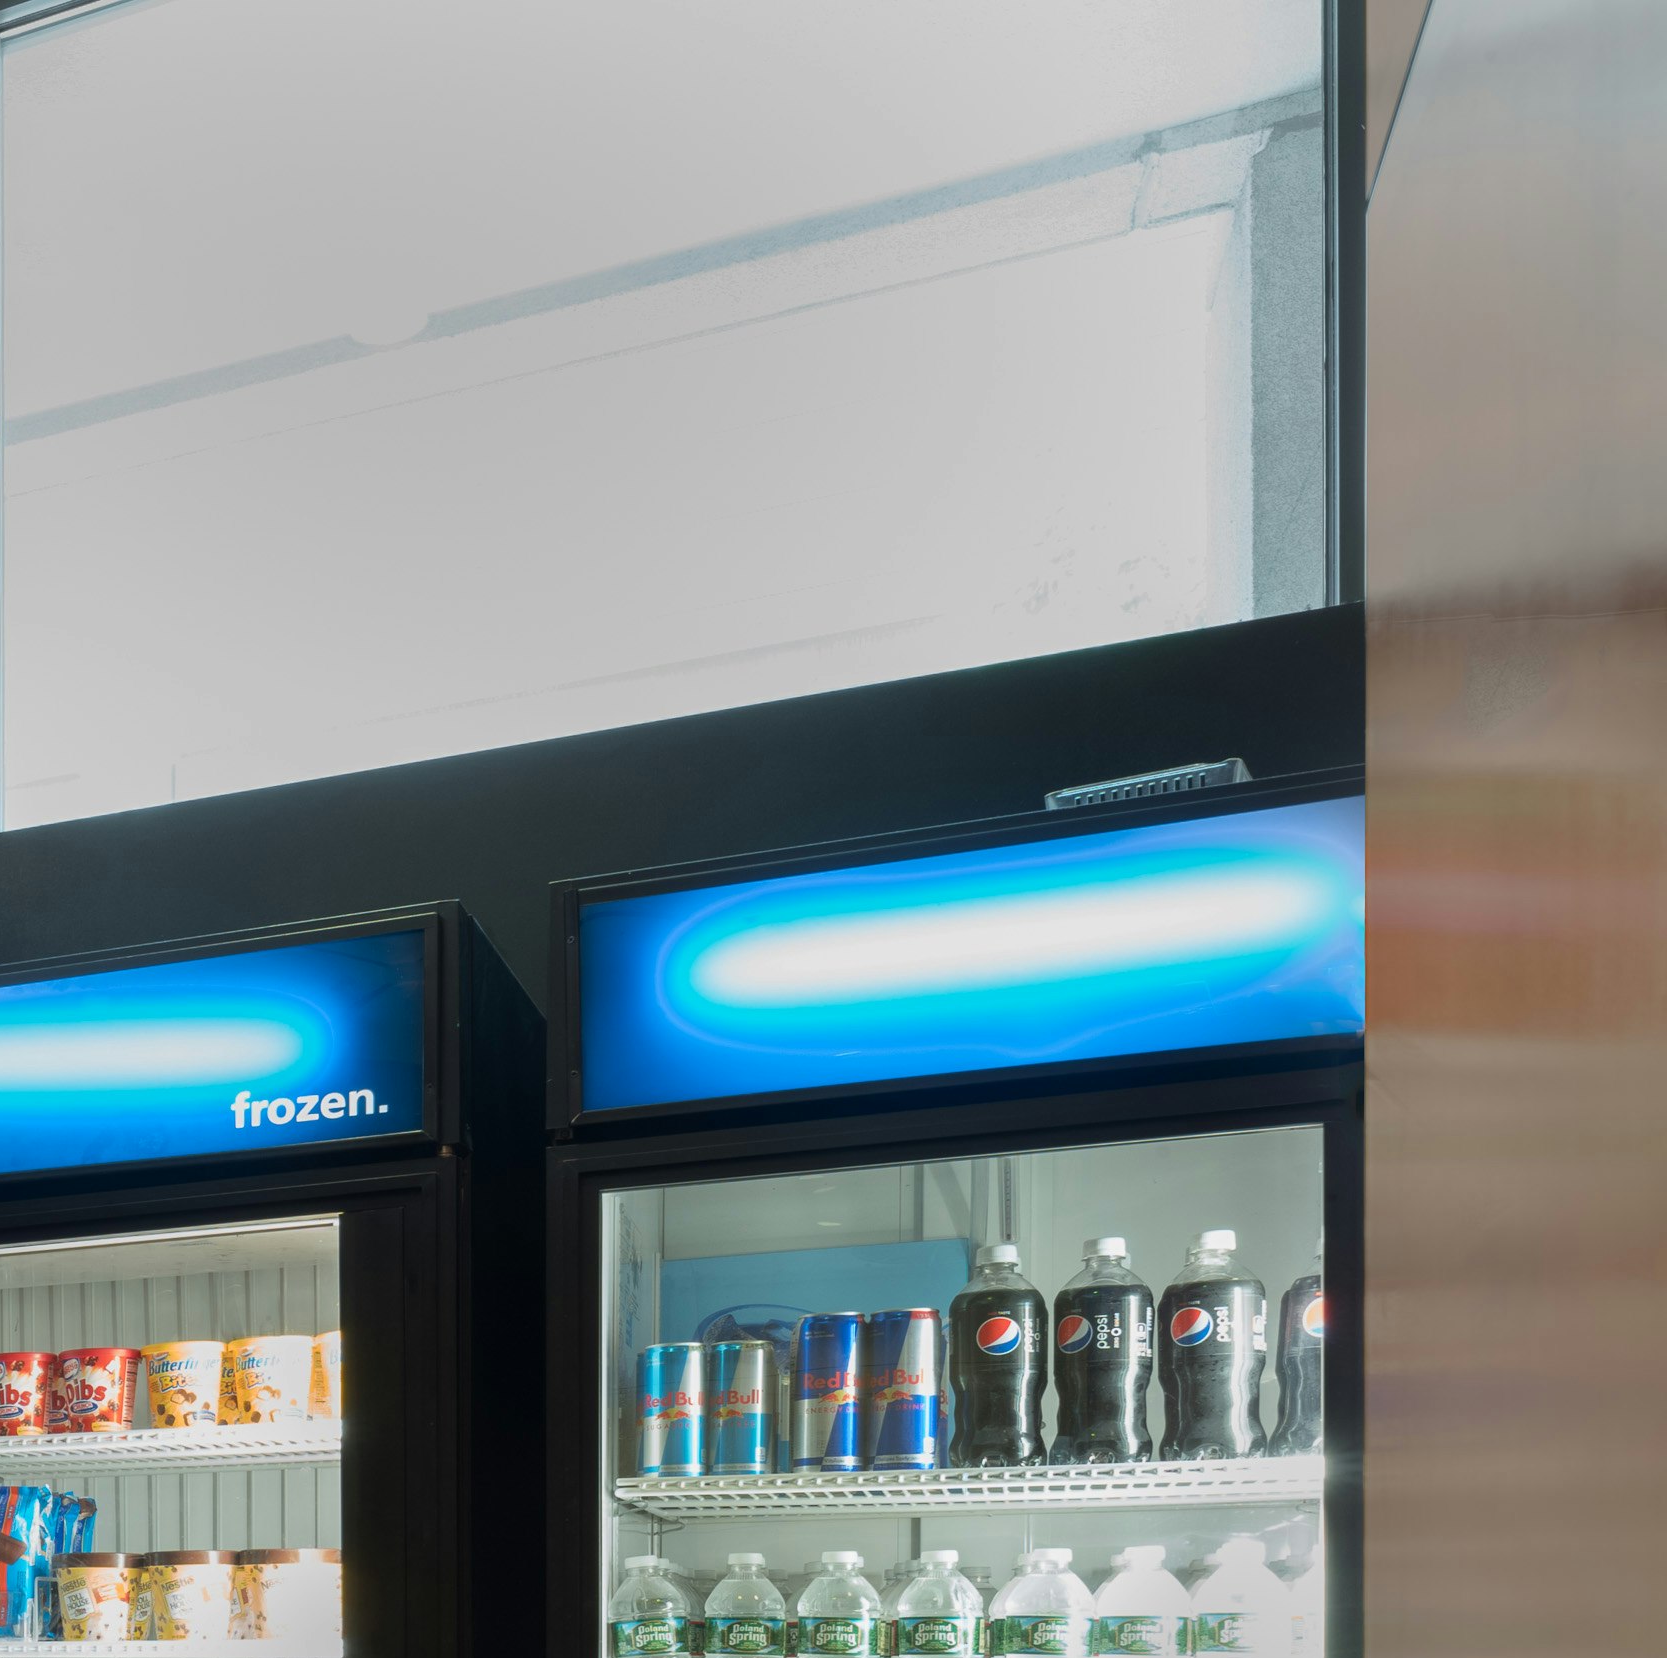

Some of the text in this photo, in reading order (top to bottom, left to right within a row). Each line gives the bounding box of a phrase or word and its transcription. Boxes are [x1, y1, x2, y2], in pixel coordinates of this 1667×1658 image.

[230, 1088, 389, 1129] frozen.
[1094, 1314, 1110, 1350] pepsi
[1216, 1306, 1232, 1343] pepsi
[803, 1372, 842, 1391] Red
[66, 1378, 108, 1404] Dibs
[726, 1389, 760, 1405] Bull
[67, 1599, 89, 1610] HOUSE
[638, 1622, 669, 1634] Poland
[733, 1622, 763, 1634] Poland
[820, 1622, 854, 1634] Poland
[919, 1622, 953, 1634] Poland
[635, 1630, 674, 1648] Spring
[729, 1630, 768, 1648] Spring
[817, 1630, 857, 1648] Spring
[915, 1630, 955, 1648] Spring
